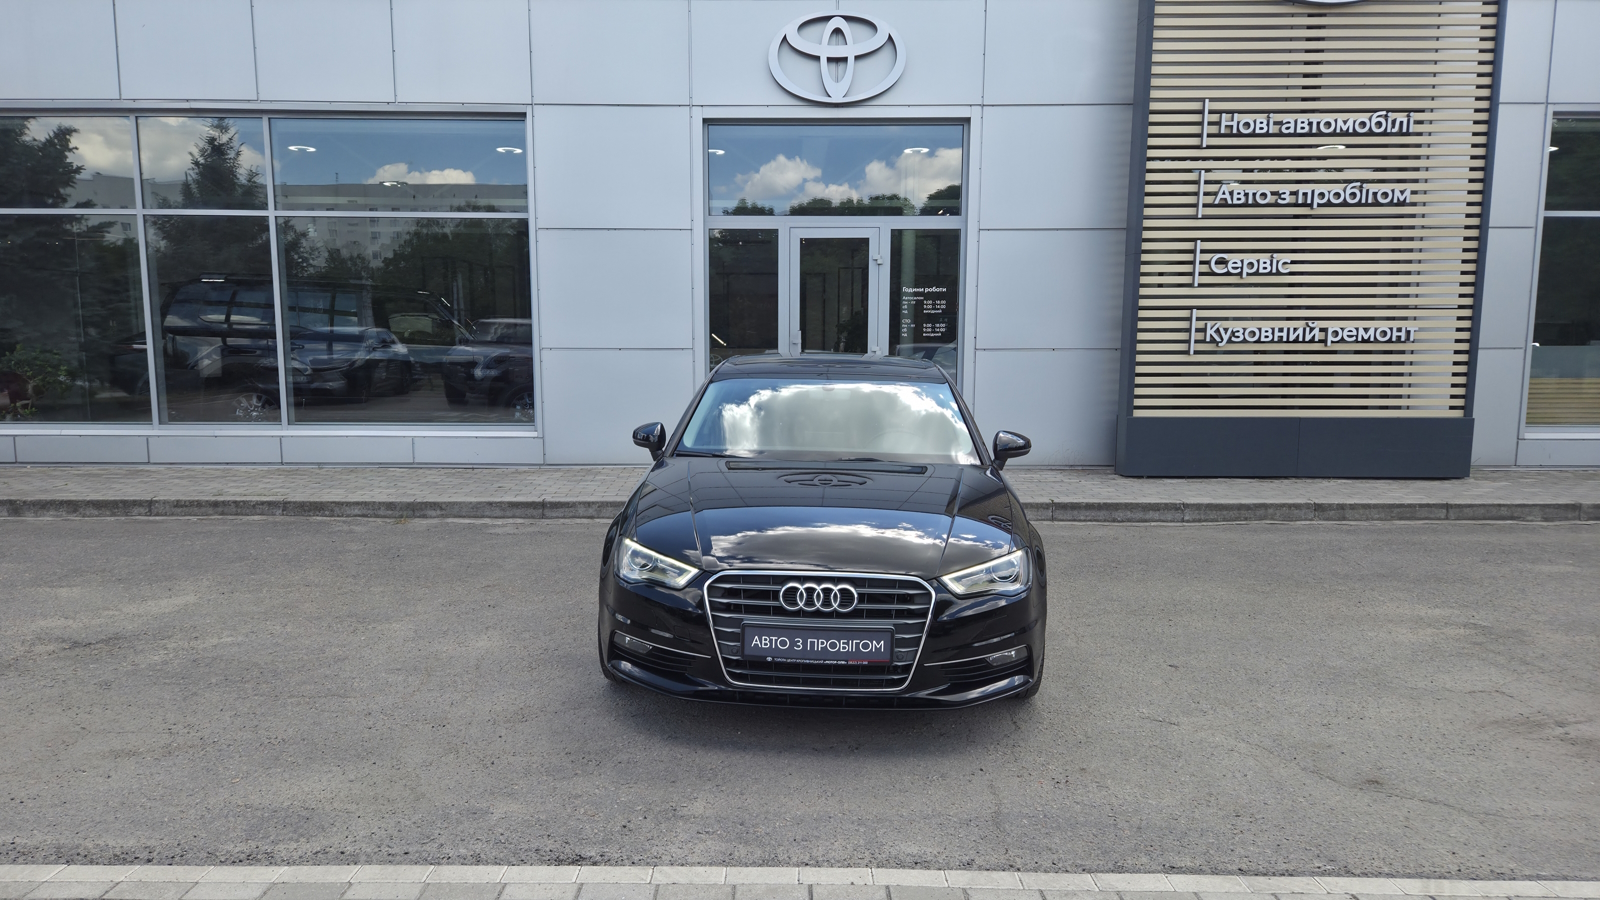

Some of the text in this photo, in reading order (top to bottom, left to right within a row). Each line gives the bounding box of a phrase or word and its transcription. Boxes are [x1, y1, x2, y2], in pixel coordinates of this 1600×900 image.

[1219, 110, 1415, 134] Нові автомобілі
[1214, 182, 1411, 209] Авто з пробігом
[1209, 253, 1292, 279] Сервіс
[1204, 321, 1419, 347] Кузовний ремонт
[751, 636, 790, 650] АВТО
[807, 638, 884, 652] ПРОБІГОМ
